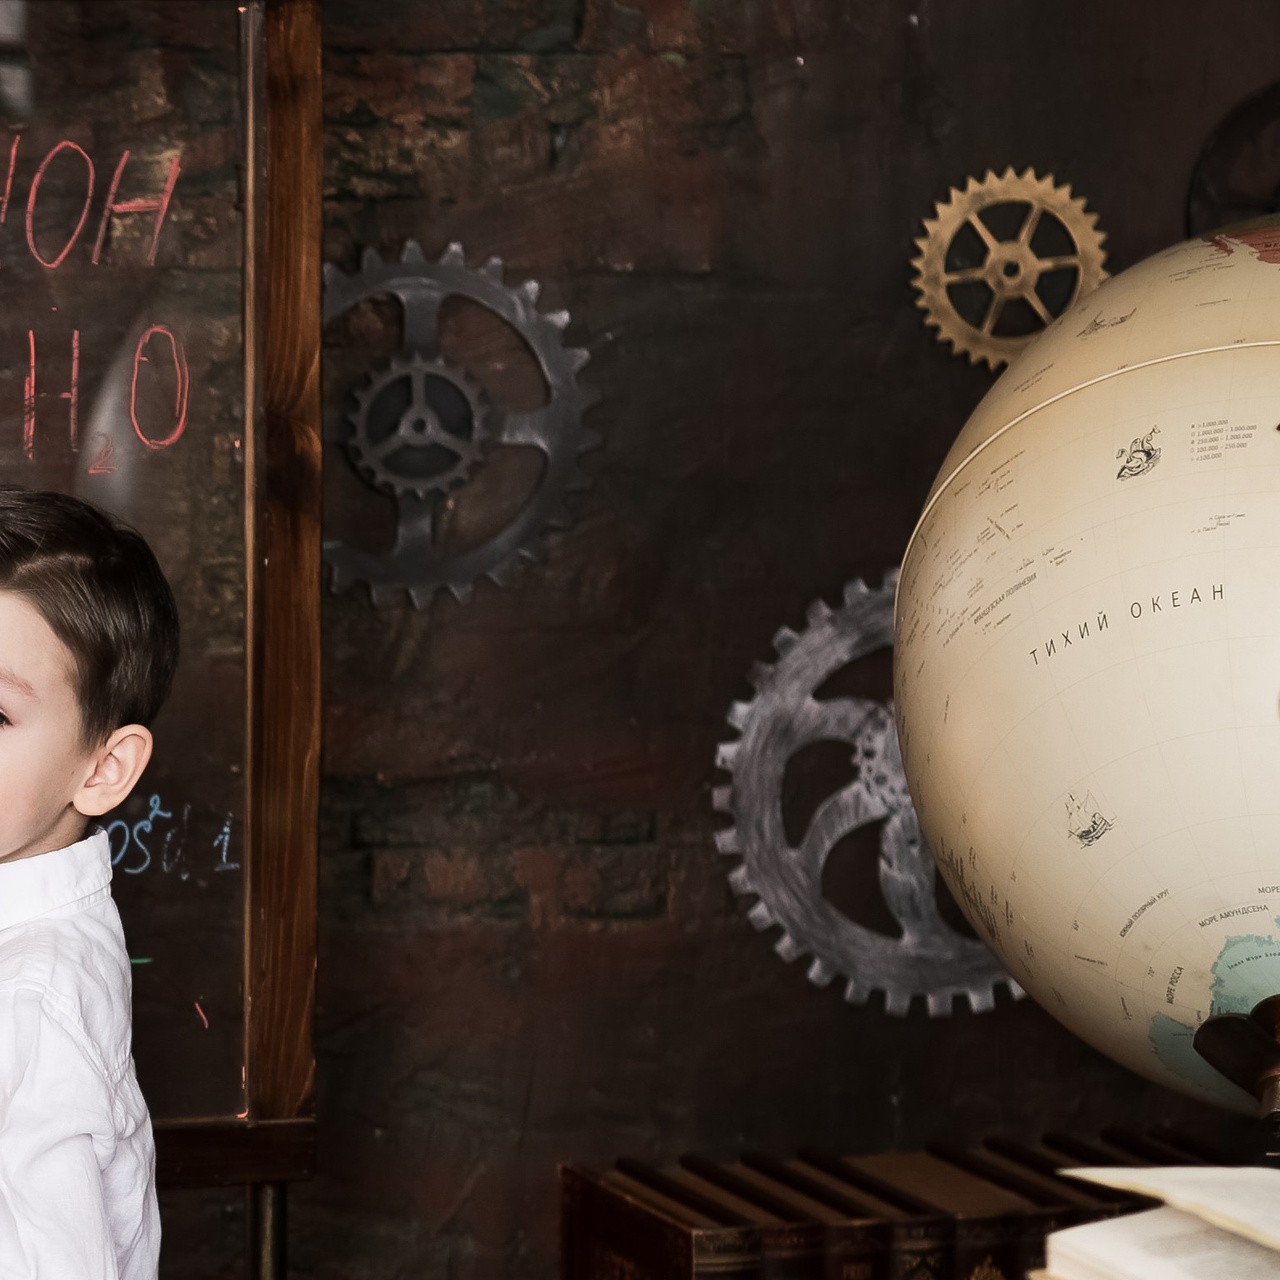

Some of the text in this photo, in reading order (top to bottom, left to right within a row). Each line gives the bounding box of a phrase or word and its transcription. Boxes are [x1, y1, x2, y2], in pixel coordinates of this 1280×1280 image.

[1029, 610, 1109, 665] ТИХИЙ
[1130, 584, 1224, 619] ОКЕАН
[1156, 888, 1170, 901] КРУГ
[1257, 885, 1280, 894] МОРЕ
[1198, 904, 1270, 928] МОРЕ АМУНДСЕНА
[1166, 966, 1184, 1004] МОРЕ РОССА
